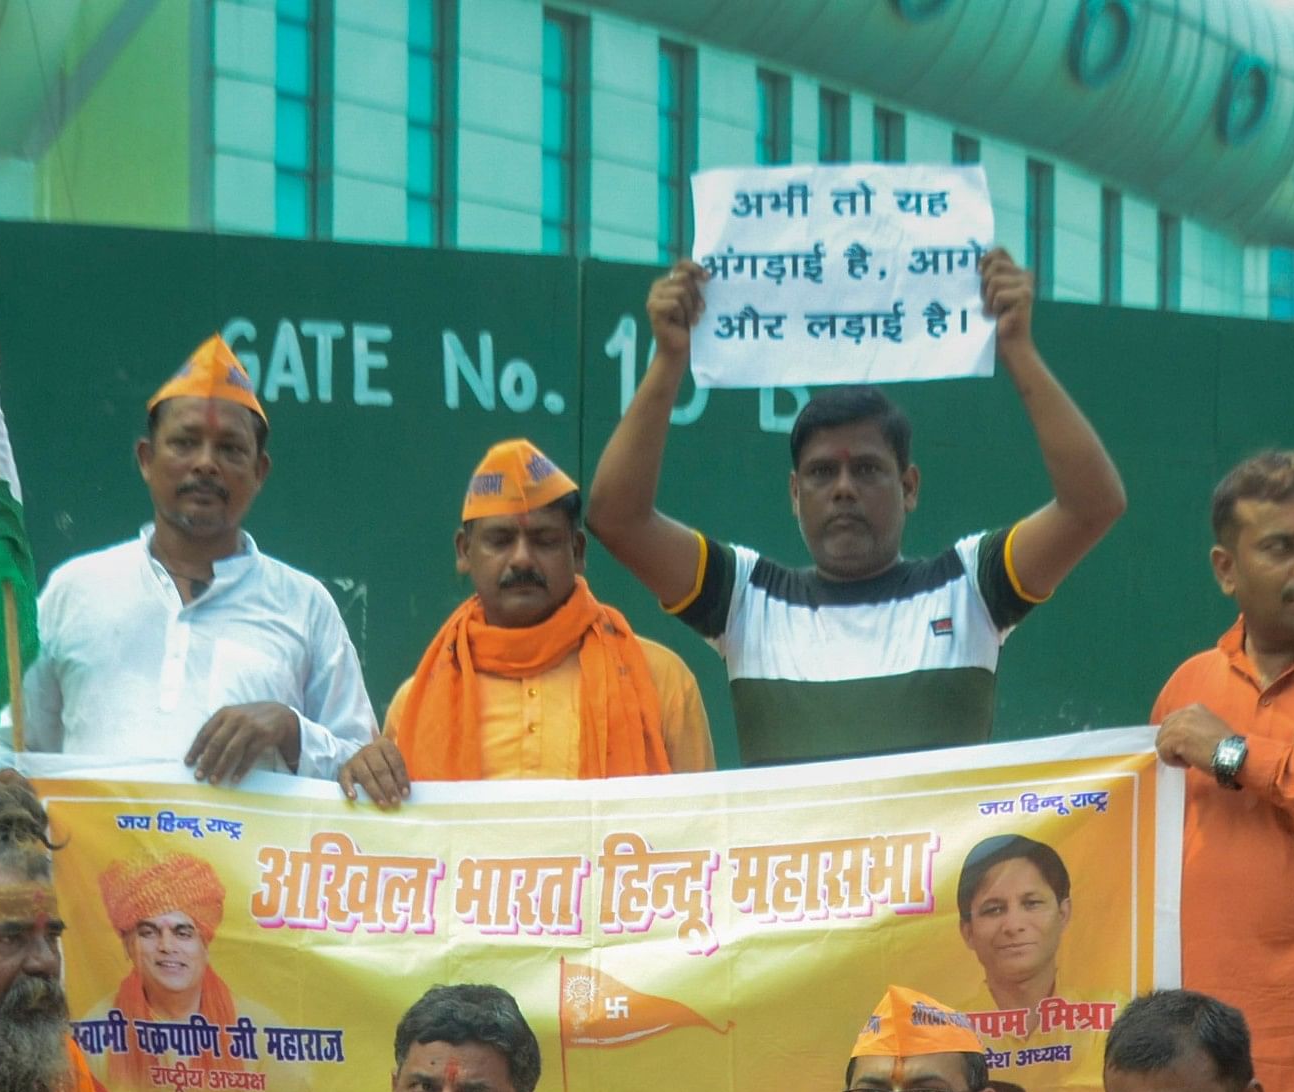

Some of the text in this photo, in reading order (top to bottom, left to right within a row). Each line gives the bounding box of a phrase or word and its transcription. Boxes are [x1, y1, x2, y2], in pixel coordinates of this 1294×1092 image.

[732, 180, 950, 218] अभी तो यह
[701, 242, 826, 285] अंगड़ाई
[714, 303, 787, 341] और
[804, 301, 905, 345] लड़ाई
[441, 329, 565, 415] No.
[978, 791, 1109, 816] जय हिन्दू राष्ट्र
[117, 811, 243, 840] जय हिन्दू राष्ट्र
[251, 831, 940, 954] अखिल भारत हिन्दू महासभा
[133, 1014, 221, 1057] चक्रपाणि
[225, 1017, 259, 1060] जी
[264, 1027, 346, 1063] महाराज
[1015, 1044, 1072, 1067] अध्यक्ष
[208, 1069, 266, 1091] अध्यक्ष
